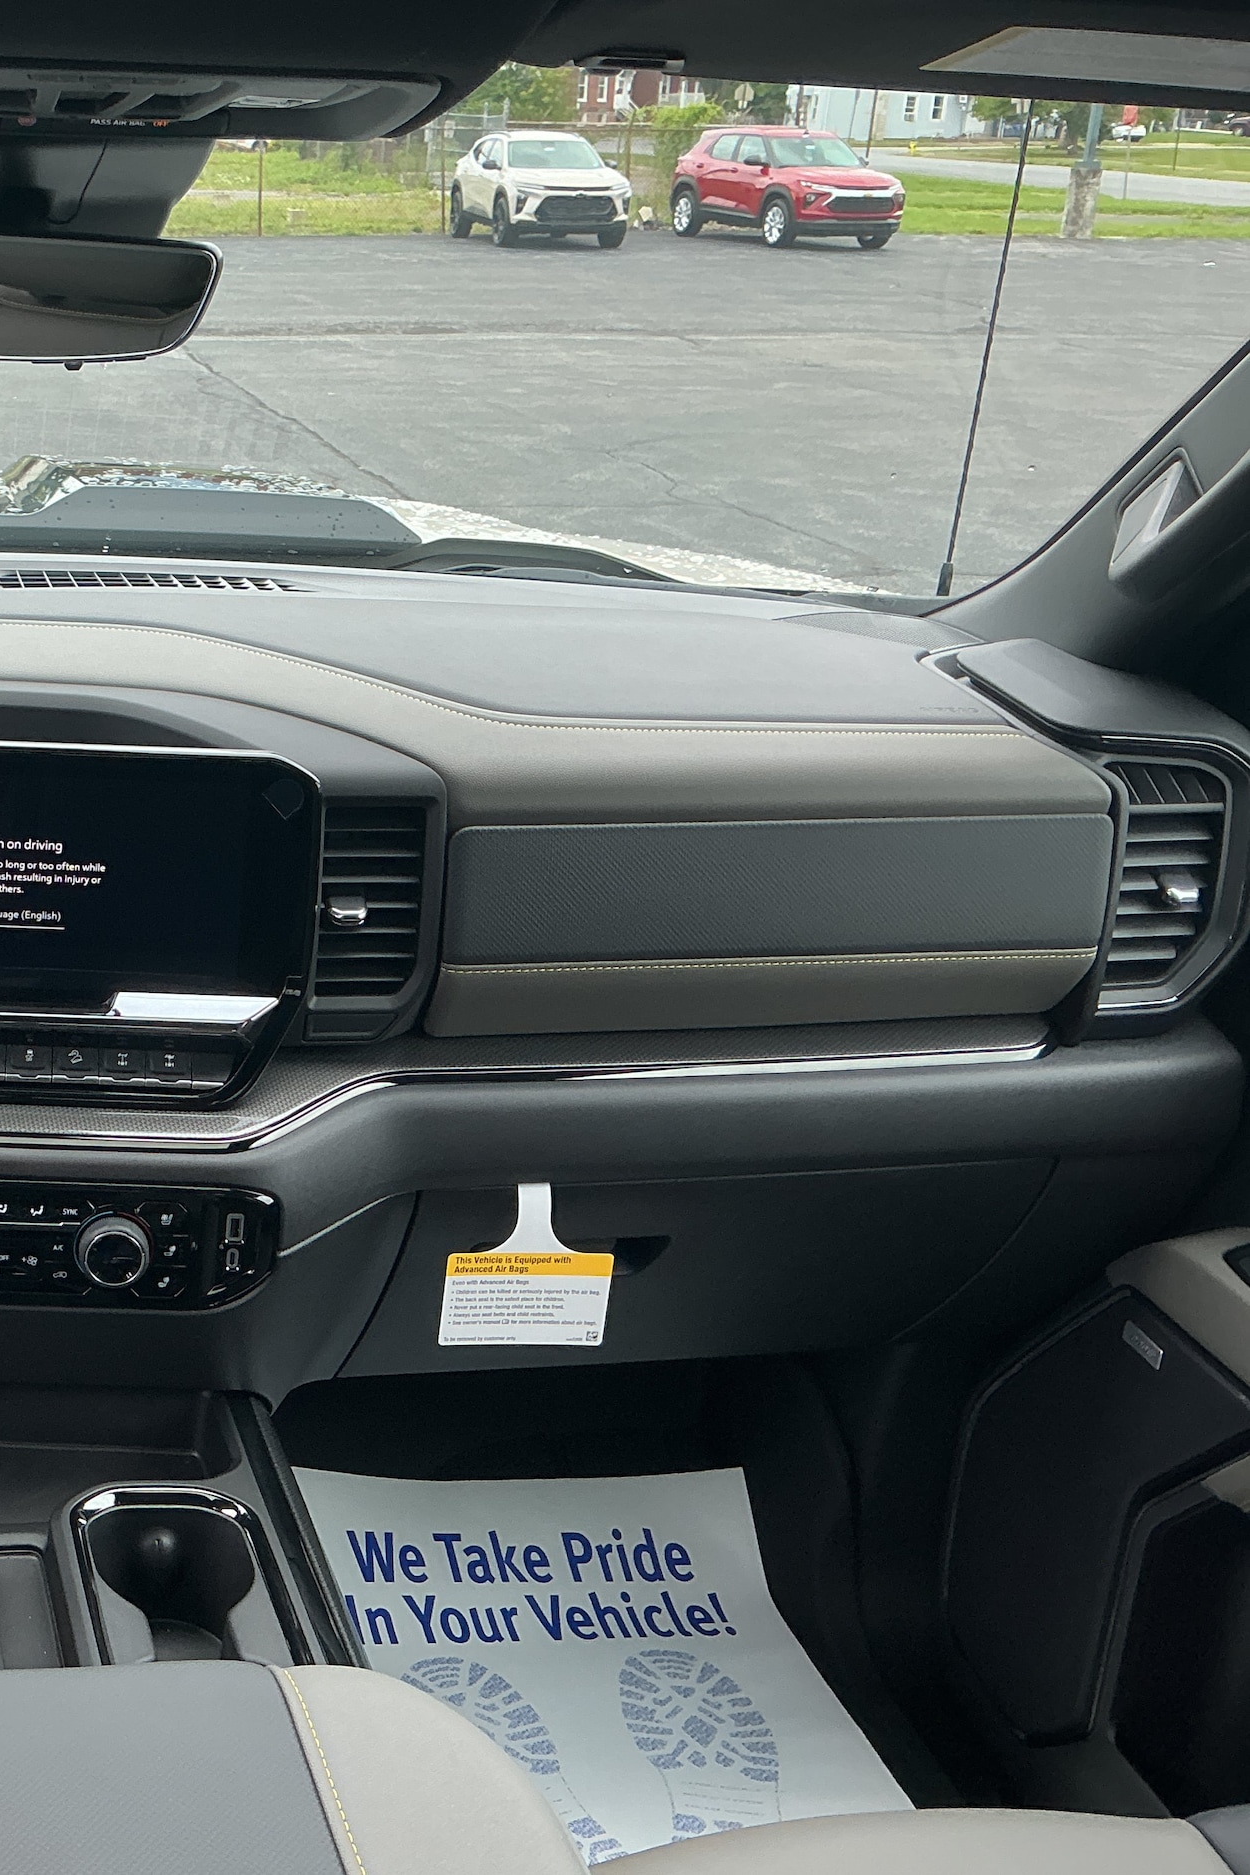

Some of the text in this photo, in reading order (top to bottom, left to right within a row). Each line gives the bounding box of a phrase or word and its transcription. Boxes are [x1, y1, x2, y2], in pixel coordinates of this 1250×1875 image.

[6, 840, 22, 850] on
[24, 838, 63, 854] driving
[5, 860, 26, 871] long
[38, 862, 54, 870] too
[56, 862, 80, 872] often
[82, 863, 106, 872] while
[14, 873, 52, 885] resulting
[54, 874, 62, 883] in
[64, 874, 90, 886] injury
[21, 910, 62, 922] (English)
[514, 1256, 552, 1266] Equipped
[454, 1266, 493, 1274] Advanced
[508, 1265, 529, 1274] Bags
[347, 1527, 694, 1584] We Take Pride
[345, 1592, 738, 1645] In Your Vehicle!
